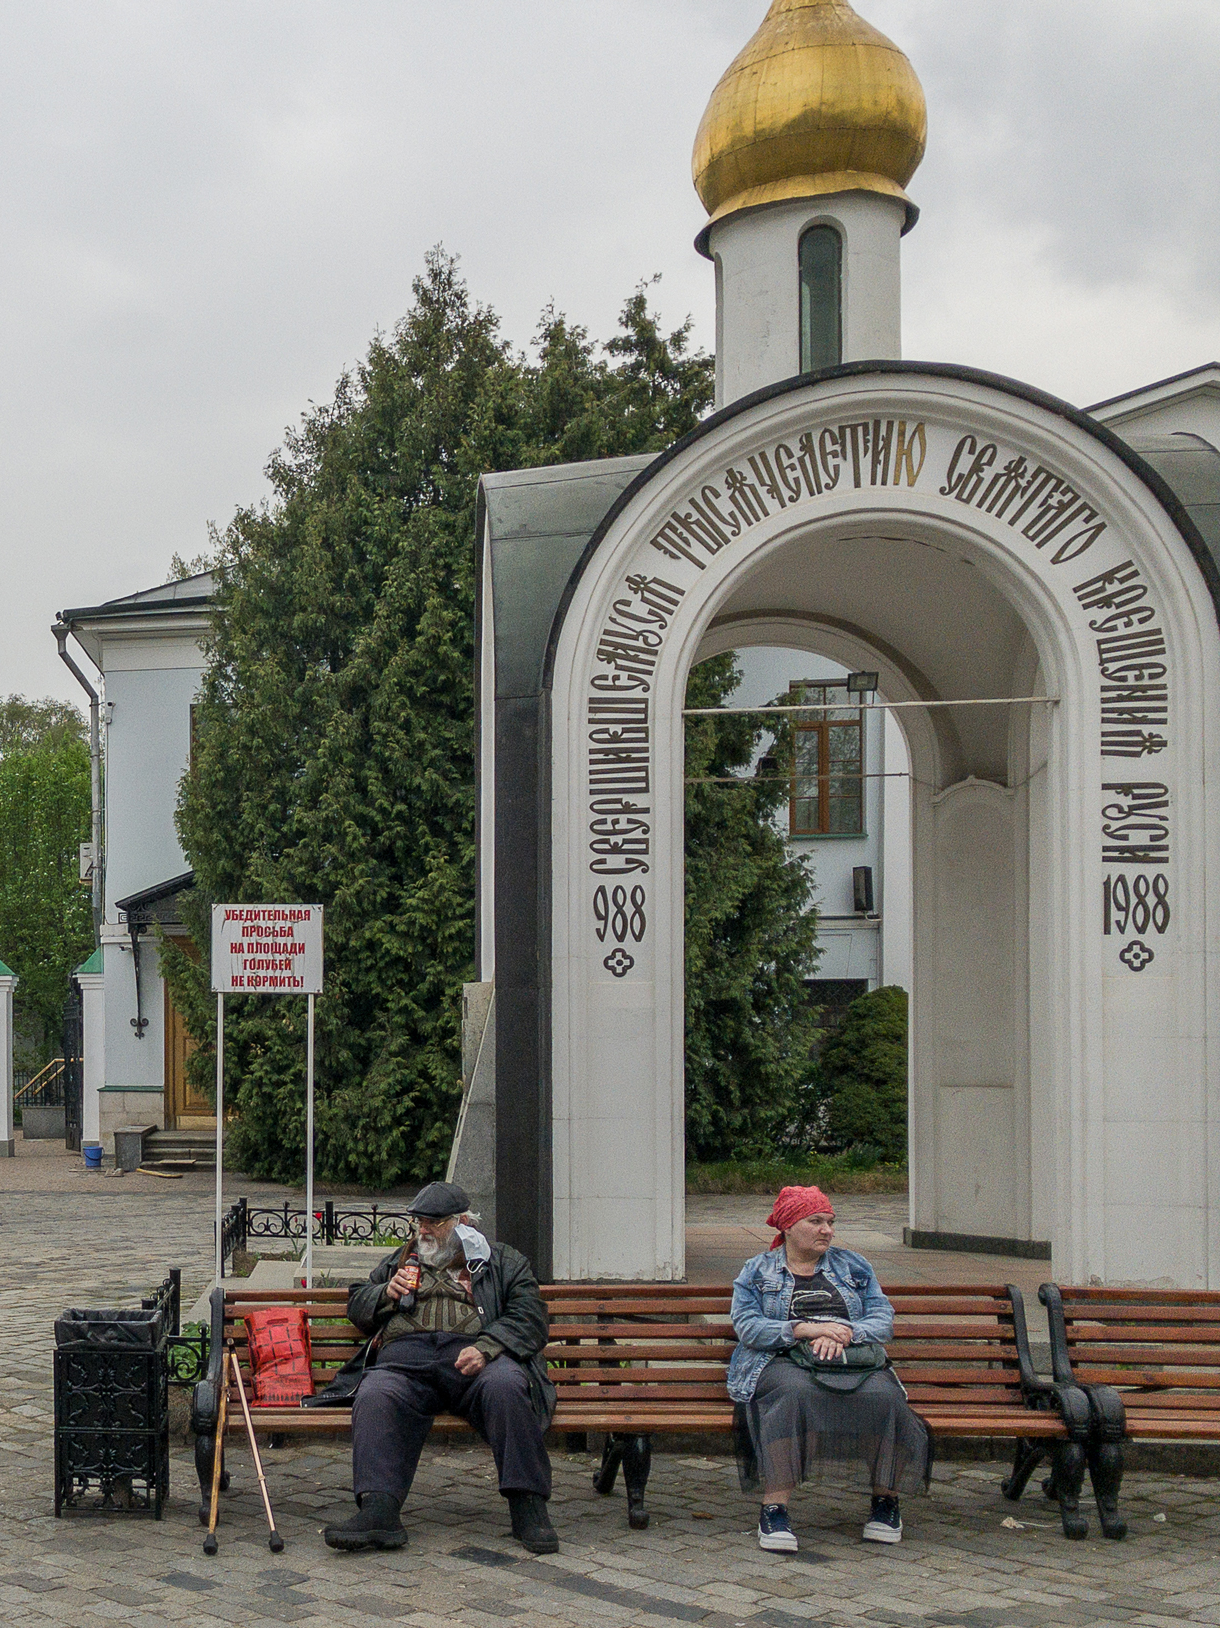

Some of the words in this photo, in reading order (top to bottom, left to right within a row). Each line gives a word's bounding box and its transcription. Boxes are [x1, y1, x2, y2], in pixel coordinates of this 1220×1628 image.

[1103, 873, 1171, 936] 1988
[224, 909, 311, 922] УБЕДИТЕЛЬНАЯ
[592, 884, 647, 943] 988
[241, 925, 294, 938] ПРОСЬБА
[230, 942, 244, 954] НА
[247, 942, 306, 955] ПЛОЩАДИ
[243, 957, 292, 970] ГОЛУБЕЙ
[231, 975, 244, 987] НЕ
[247, 975, 304, 988] КОРМИТЬ!
